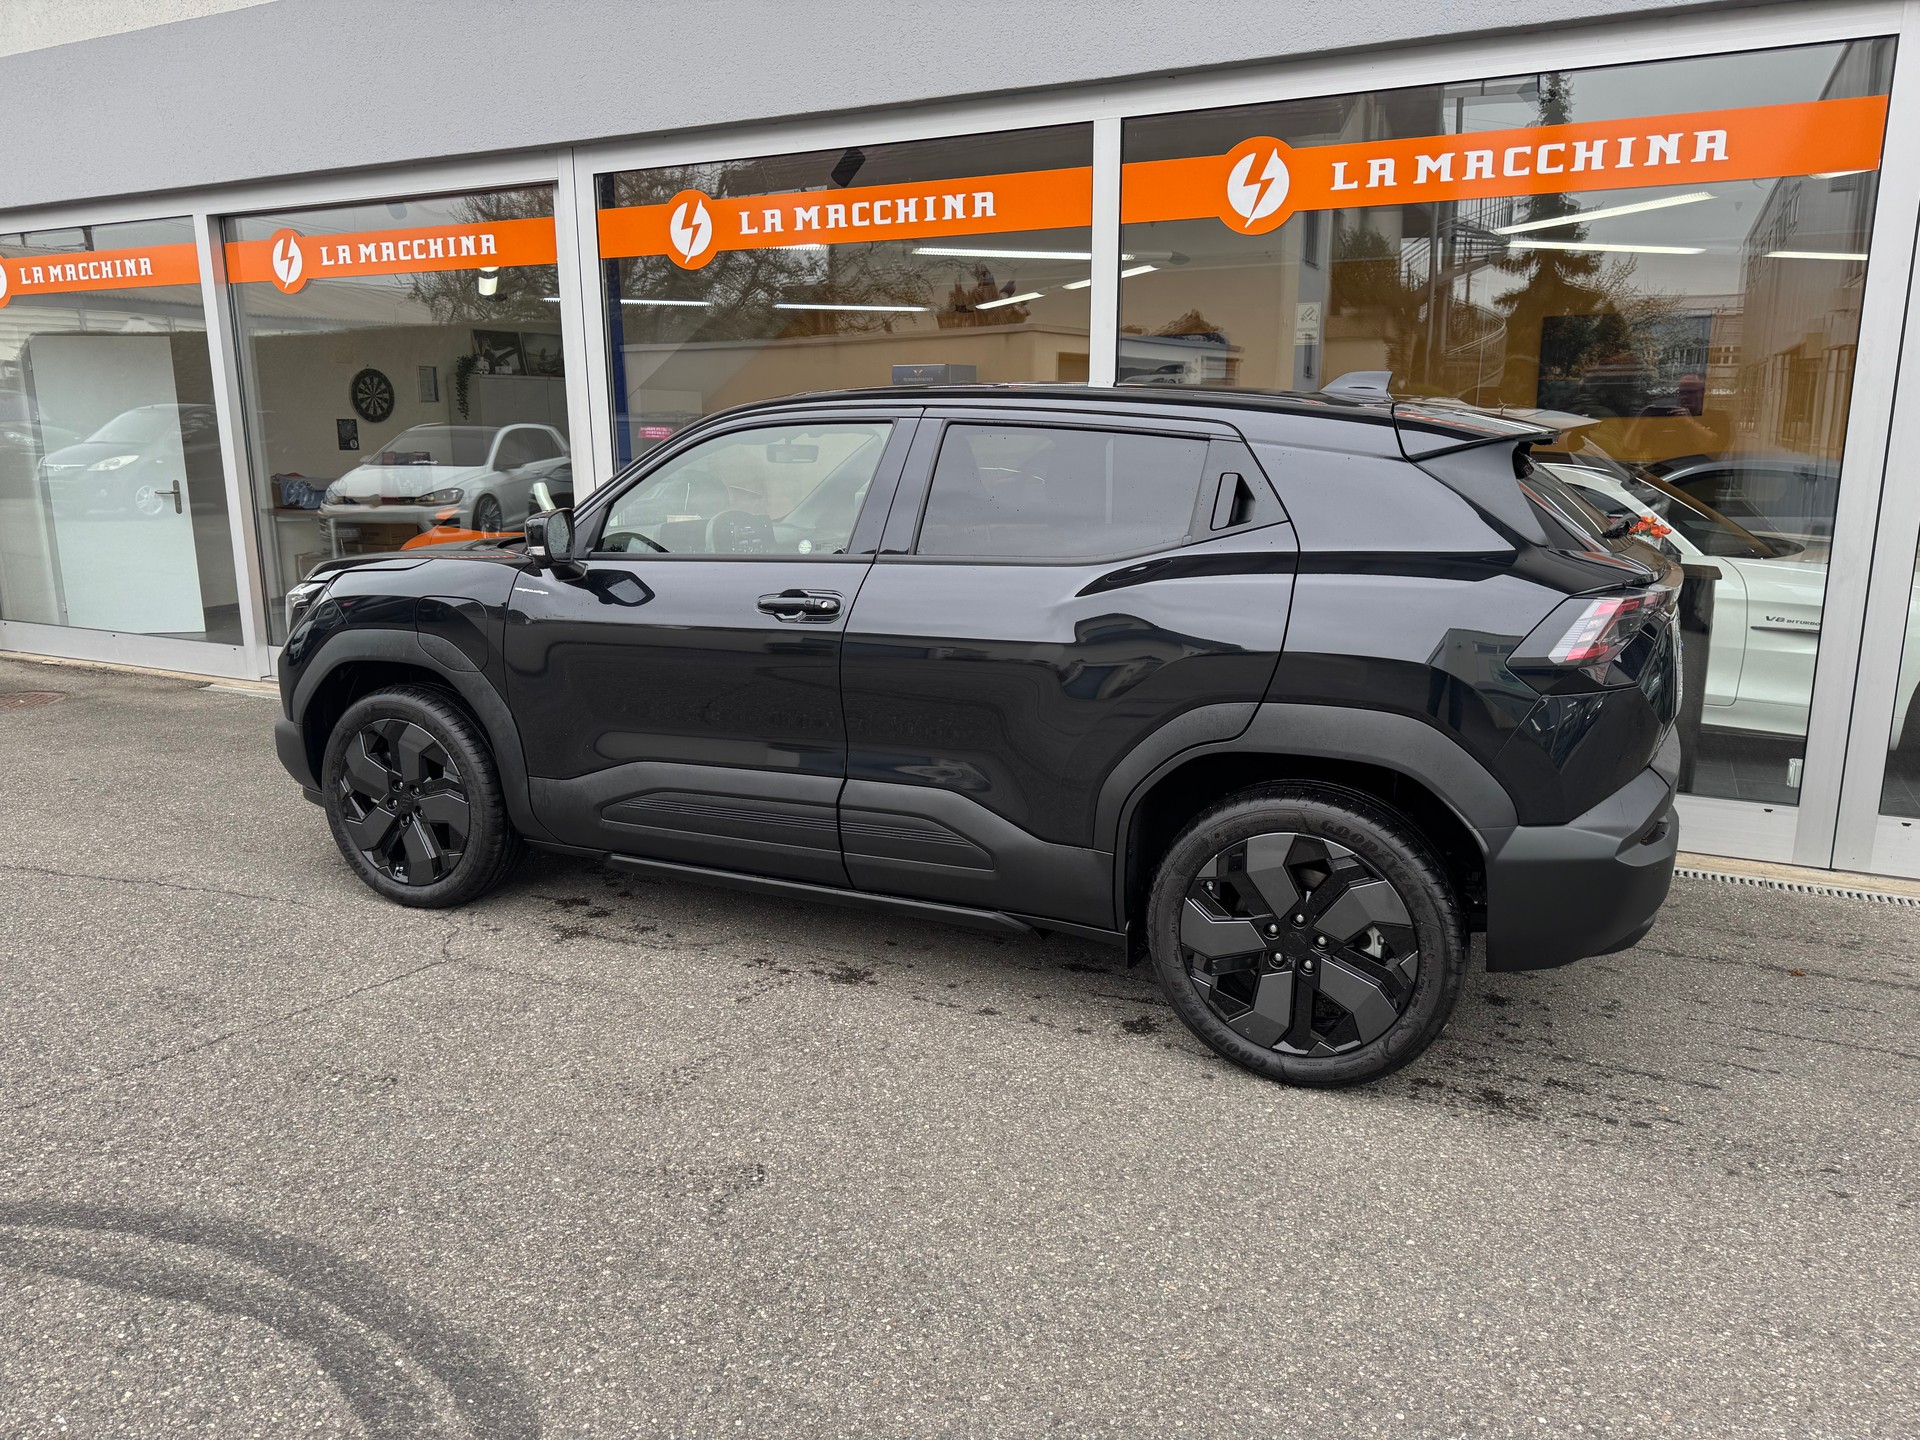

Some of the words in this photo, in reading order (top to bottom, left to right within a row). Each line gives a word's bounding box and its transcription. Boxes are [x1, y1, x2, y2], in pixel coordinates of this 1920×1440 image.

[1330, 158, 1398, 191] LA
[1413, 130, 1729, 184] MACCHINA
[738, 209, 784, 235] LA
[793, 192, 997, 231] MACCHINA
[319, 245, 353, 266] LA
[357, 234, 498, 264] MACCHINA
[19, 266, 46, 285] LA
[48, 258, 153, 283] MACCHINA
[1766, 615, 1785, 623] V8
